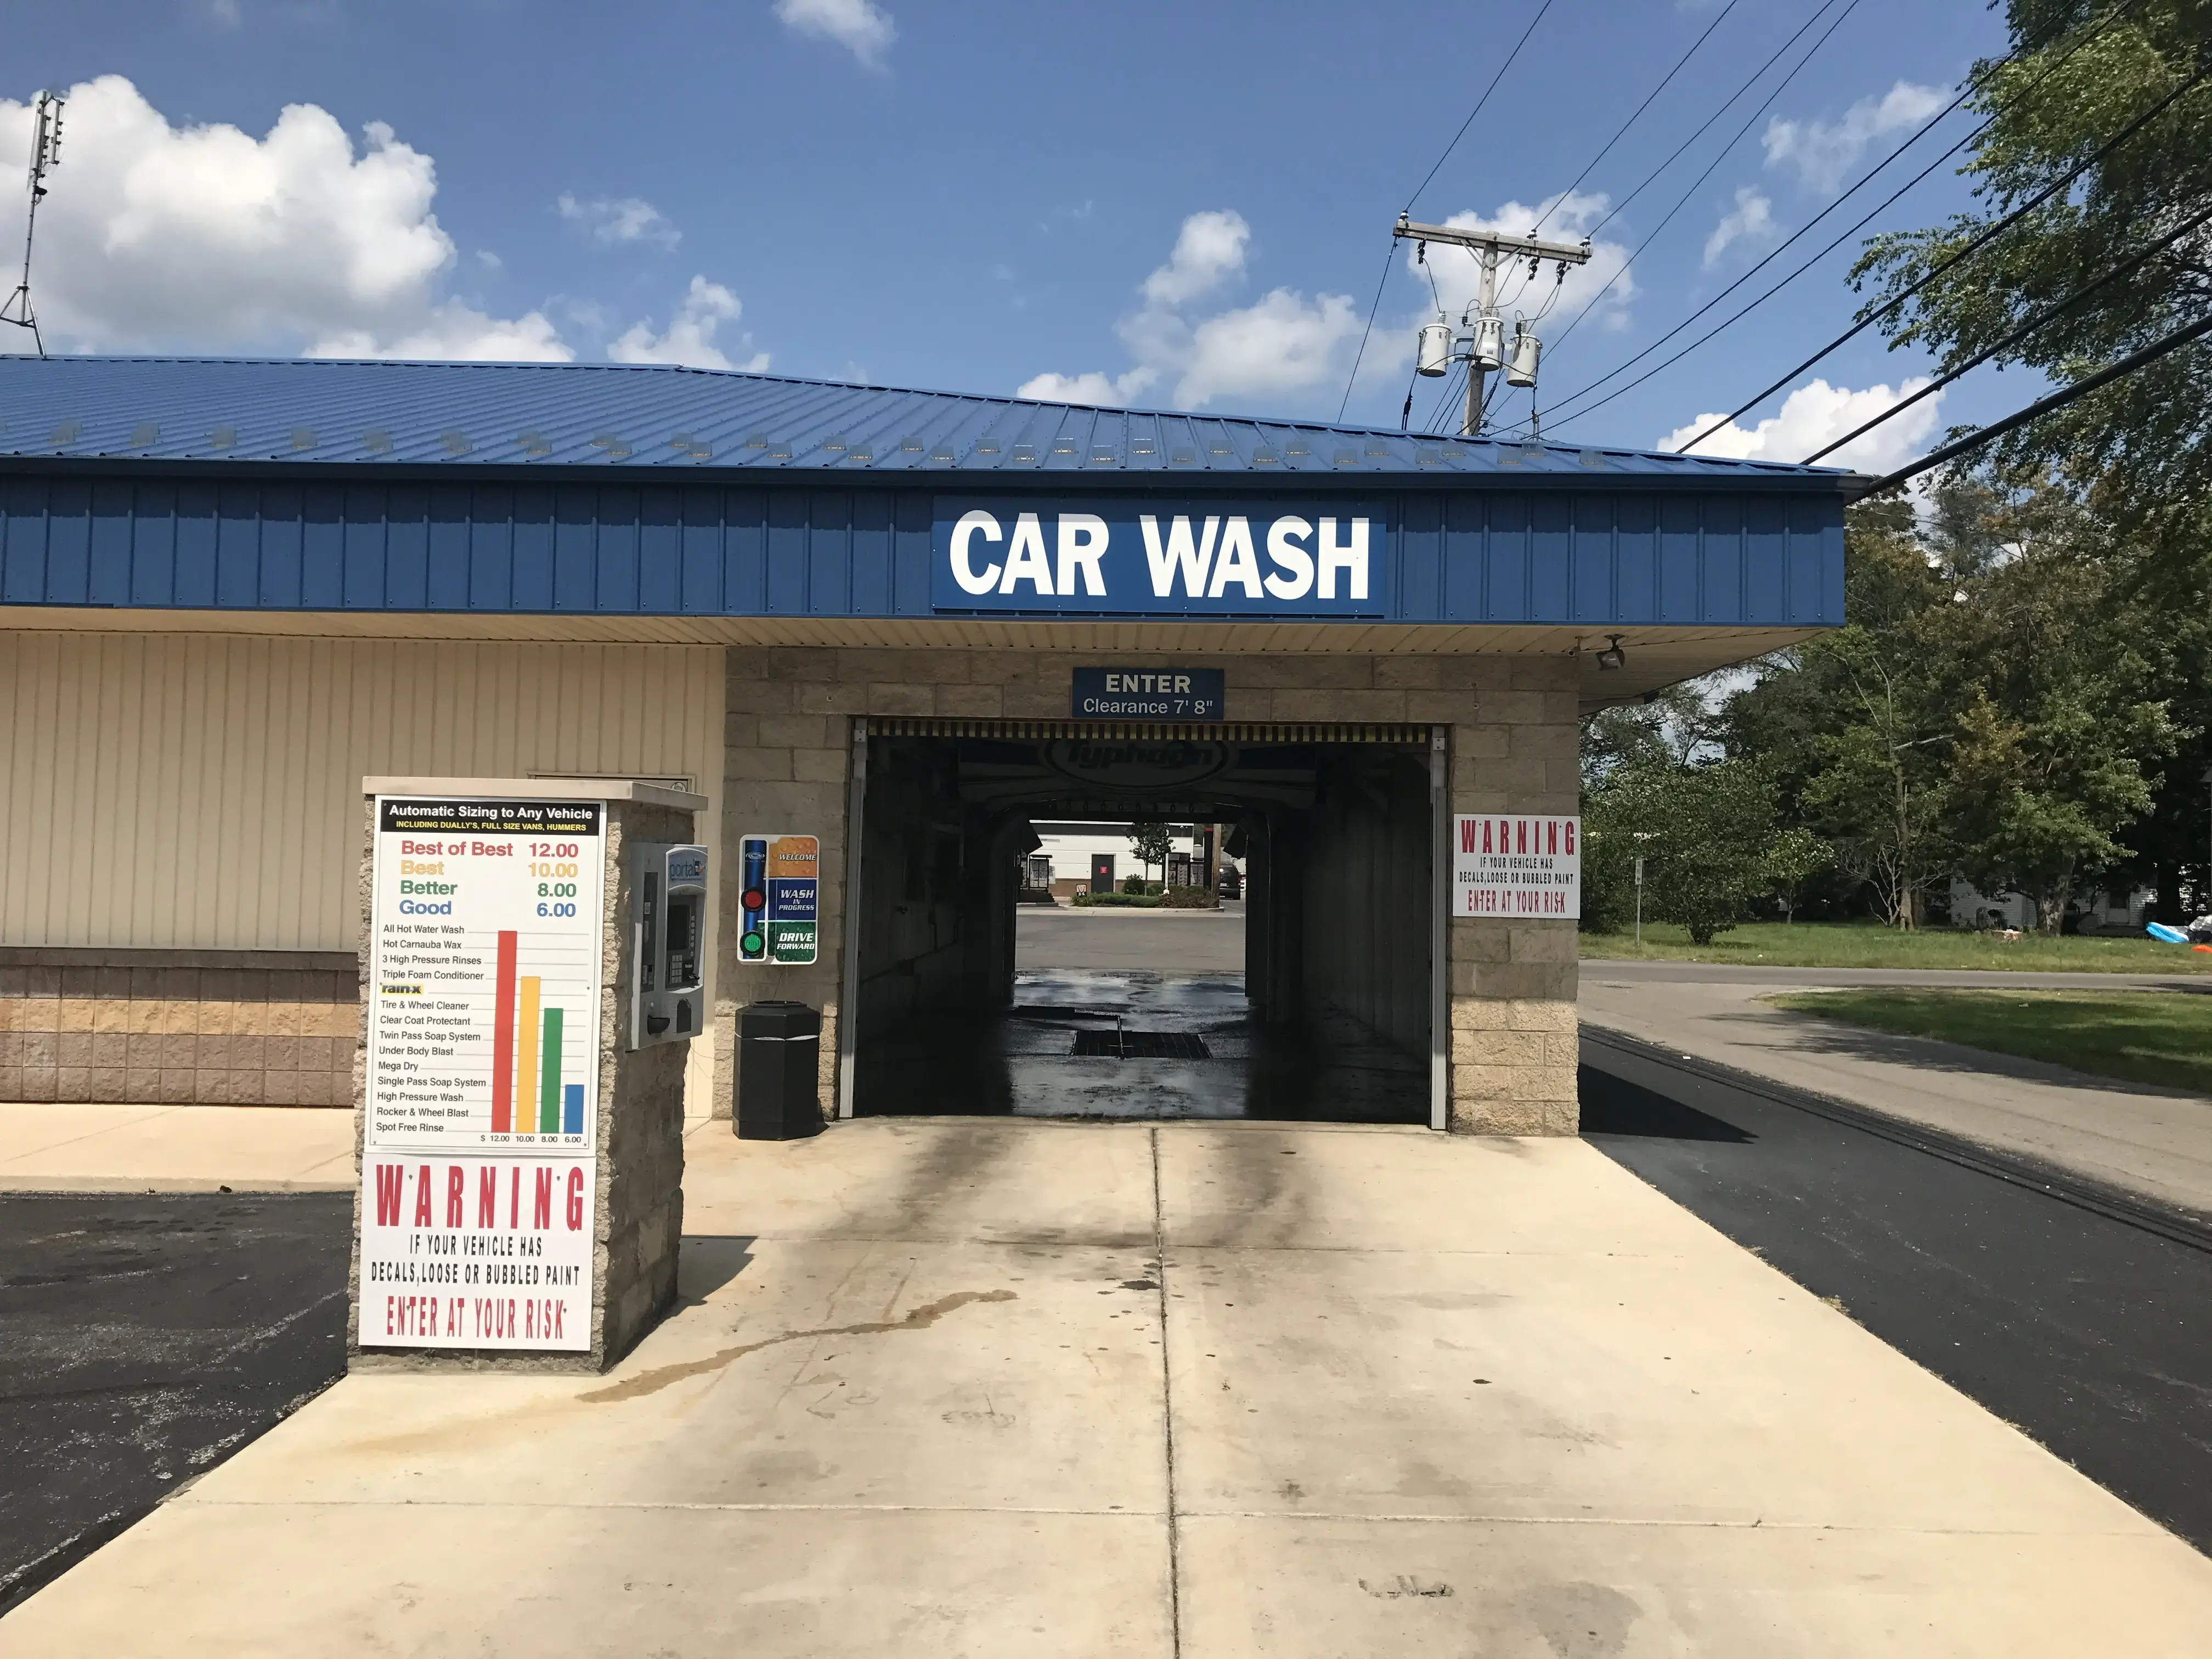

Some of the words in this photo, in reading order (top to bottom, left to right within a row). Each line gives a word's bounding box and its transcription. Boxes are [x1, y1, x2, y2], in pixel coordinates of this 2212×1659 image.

[950, 510, 1109, 596] CAR
[1139, 515, 1369, 600] WASH
[1106, 675, 1191, 693] ENTER
[1084, 698, 1167, 714] Clearance
[1174, 700, 1188, 714] 7'
[1194, 700, 1212, 714] 8"
[389, 805, 454, 817] Automatic
[458, 806, 498, 820] Sizing
[501, 808, 514, 817] to
[517, 808, 543, 820] Any
[546, 808, 592, 819] Vehicle
[440, 821, 479, 830] DUALLY'S,
[522, 823, 544, 831] VANS,
[1461, 820, 1574, 855] WARNING
[402, 840, 442, 855] Best
[448, 841, 467, 855] of
[471, 842, 513, 856] Best
[529, 843, 578, 857] 12.00
[401, 860, 444, 874] Best
[528, 863, 578, 877] 10.00
[1481, 857, 1486, 867] IF
[1490, 857, 1506, 868] YOUR
[1510, 858, 1537, 868] VEHICLE
[1541, 859, 1553, 869] HAS
[1511, 873, 1519, 883] OR
[1523, 873, 1551, 884] BUBBLED
[1555, 873, 1573, 884] PAINT
[400, 880, 457, 895] Better
[538, 883, 577, 897] 8.00
[781, 890, 814, 898] WASH
[1469, 890, 1496, 912] ENTER
[1502, 891, 1511, 912] AT
[1517, 891, 1539, 912] YOUR
[1545, 891, 1565, 913] RISK
[399, 900, 452, 915] Good
[537, 902, 575, 917] 6.00
[383, 924, 394, 933] All
[441, 926, 464, 934] Wash
[779, 933, 814, 941] DRIVE
[400, 940, 441, 949] Carnauba
[444, 941, 461, 949] Wax
[390, 955, 409, 965] High
[412, 956, 449, 964] Pressure
[453, 956, 481, 964] Rinses
[382, 970, 405, 980] Triple
[408, 970, 431, 979] Foam
[434, 971, 484, 980] Conditioner
[381, 1000, 397, 1008] Tire
[437, 1001, 469, 1009] Cleaner
[380, 1015, 402, 1024] Clear
[405, 1016, 424, 1024] Coat
[427, 1017, 470, 1025] Protectant
[380, 1031, 398, 1039] Twin
[402, 1031, 422, 1040] Pass
[425, 1032, 446, 1041] Soap
[449, 1032, 481, 1042] System
[379, 1046, 404, 1054] Under
[408, 1047, 429, 1057] Body
[379, 1062, 401, 1071] Mega
[404, 1062, 418, 1072] Dry
[378, 1076, 404, 1087] Single
[430, 1078, 452, 1088] Soap
[454, 1078, 486, 1088] System
[377, 1092, 397, 1102] High
[399, 1093, 437, 1101] Pressure
[377, 1107, 407, 1115] Rocker
[419, 1108, 444, 1116] Wheel
[447, 1109, 469, 1117] Blast
[376, 1122, 396, 1132] Spot
[399, 1123, 416, 1131] Free
[420, 1124, 444, 1132] Rinse
[376, 1165, 583, 1231] WARNING
[410, 1235, 420, 1254] IF
[428, 1235, 456, 1255] YOUR
[464, 1235, 512, 1256] VEHICLE
[521, 1237, 541, 1256] HAS
[466, 1265, 478, 1283] OR
[487, 1265, 538, 1285] BUBBLED
[546, 1266, 579, 1285] PAINT
[387, 1296, 437, 1336] ENTER
[447, 1298, 464, 1336] AT
[475, 1299, 515, 1338] YOUR
[526, 1299, 563, 1339] RISK
